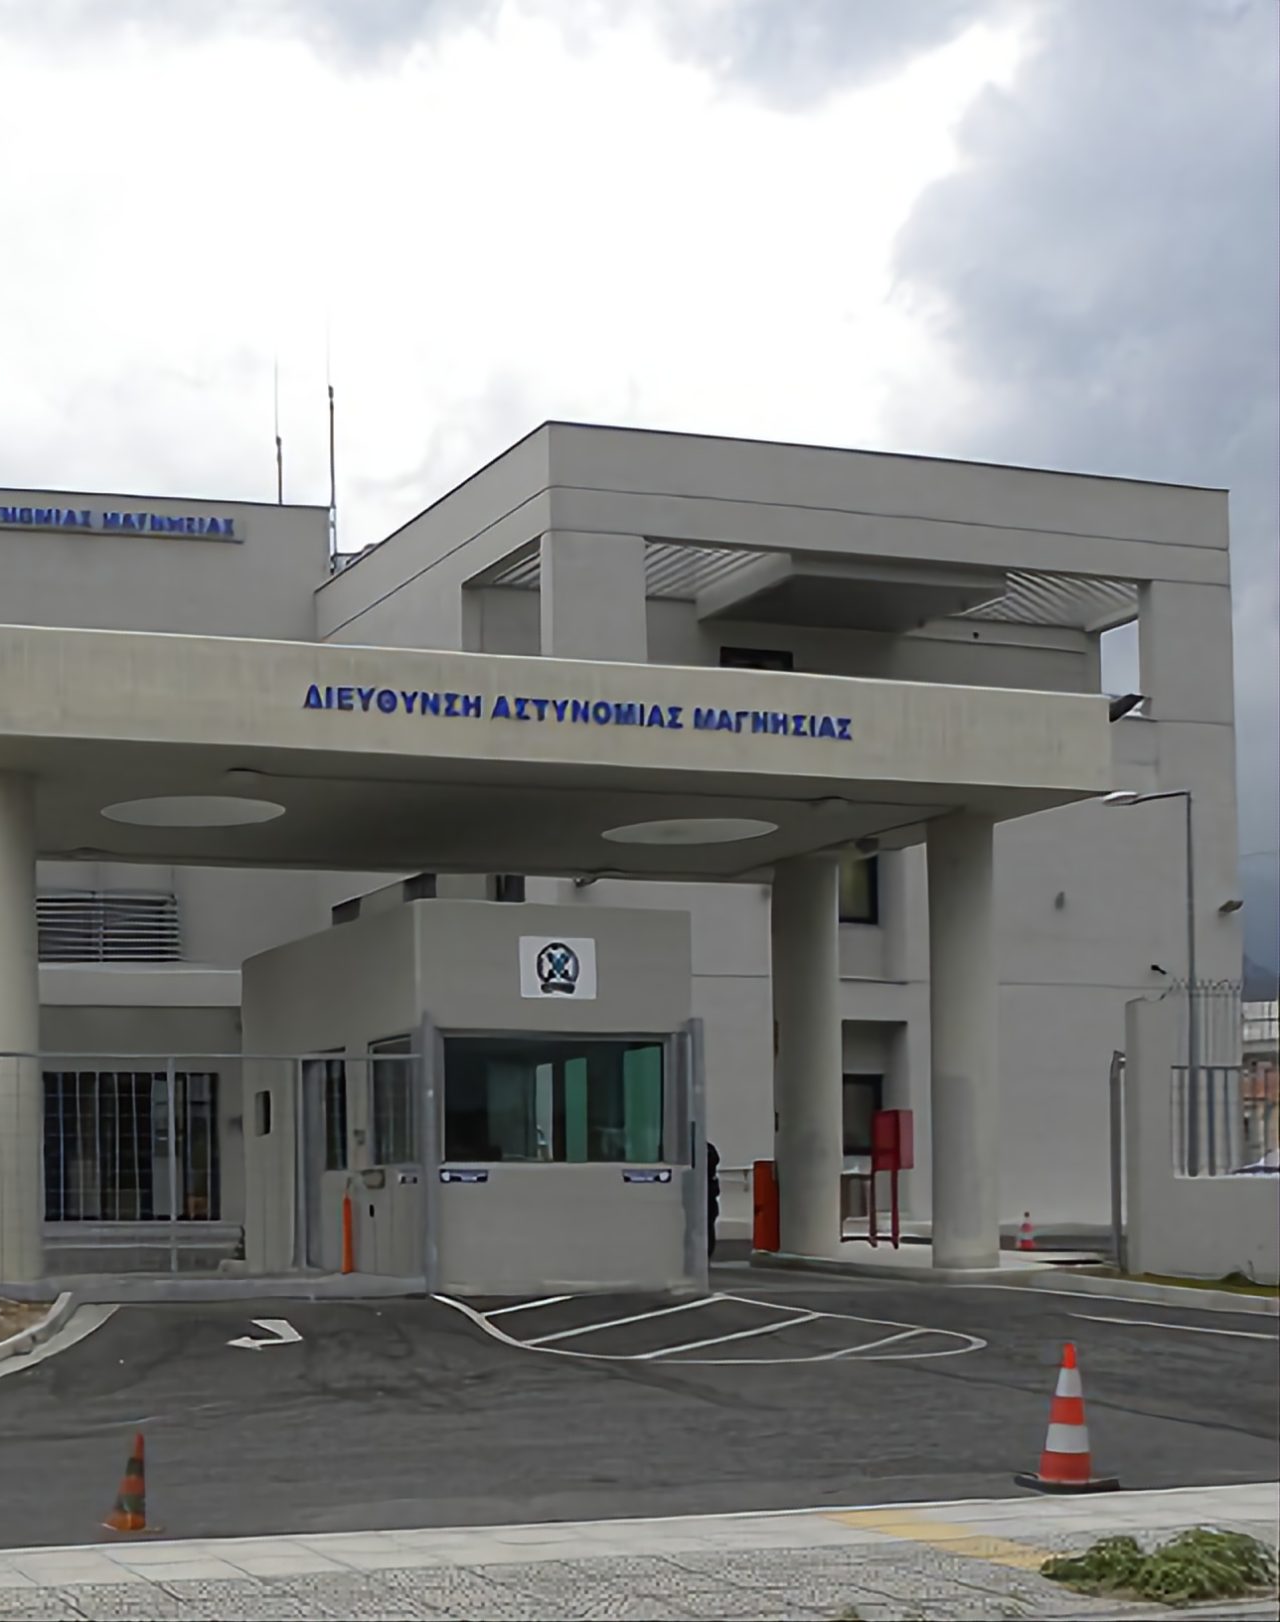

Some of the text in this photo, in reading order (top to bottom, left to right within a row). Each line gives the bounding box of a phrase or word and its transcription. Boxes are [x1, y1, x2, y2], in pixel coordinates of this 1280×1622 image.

[304, 684, 853, 740] ΔΙΕΥΘΥΝΣΗ ΑΣΤΥΝΟΜΙΑΣ ΜΑΓΝΗΣΙΑΣ
